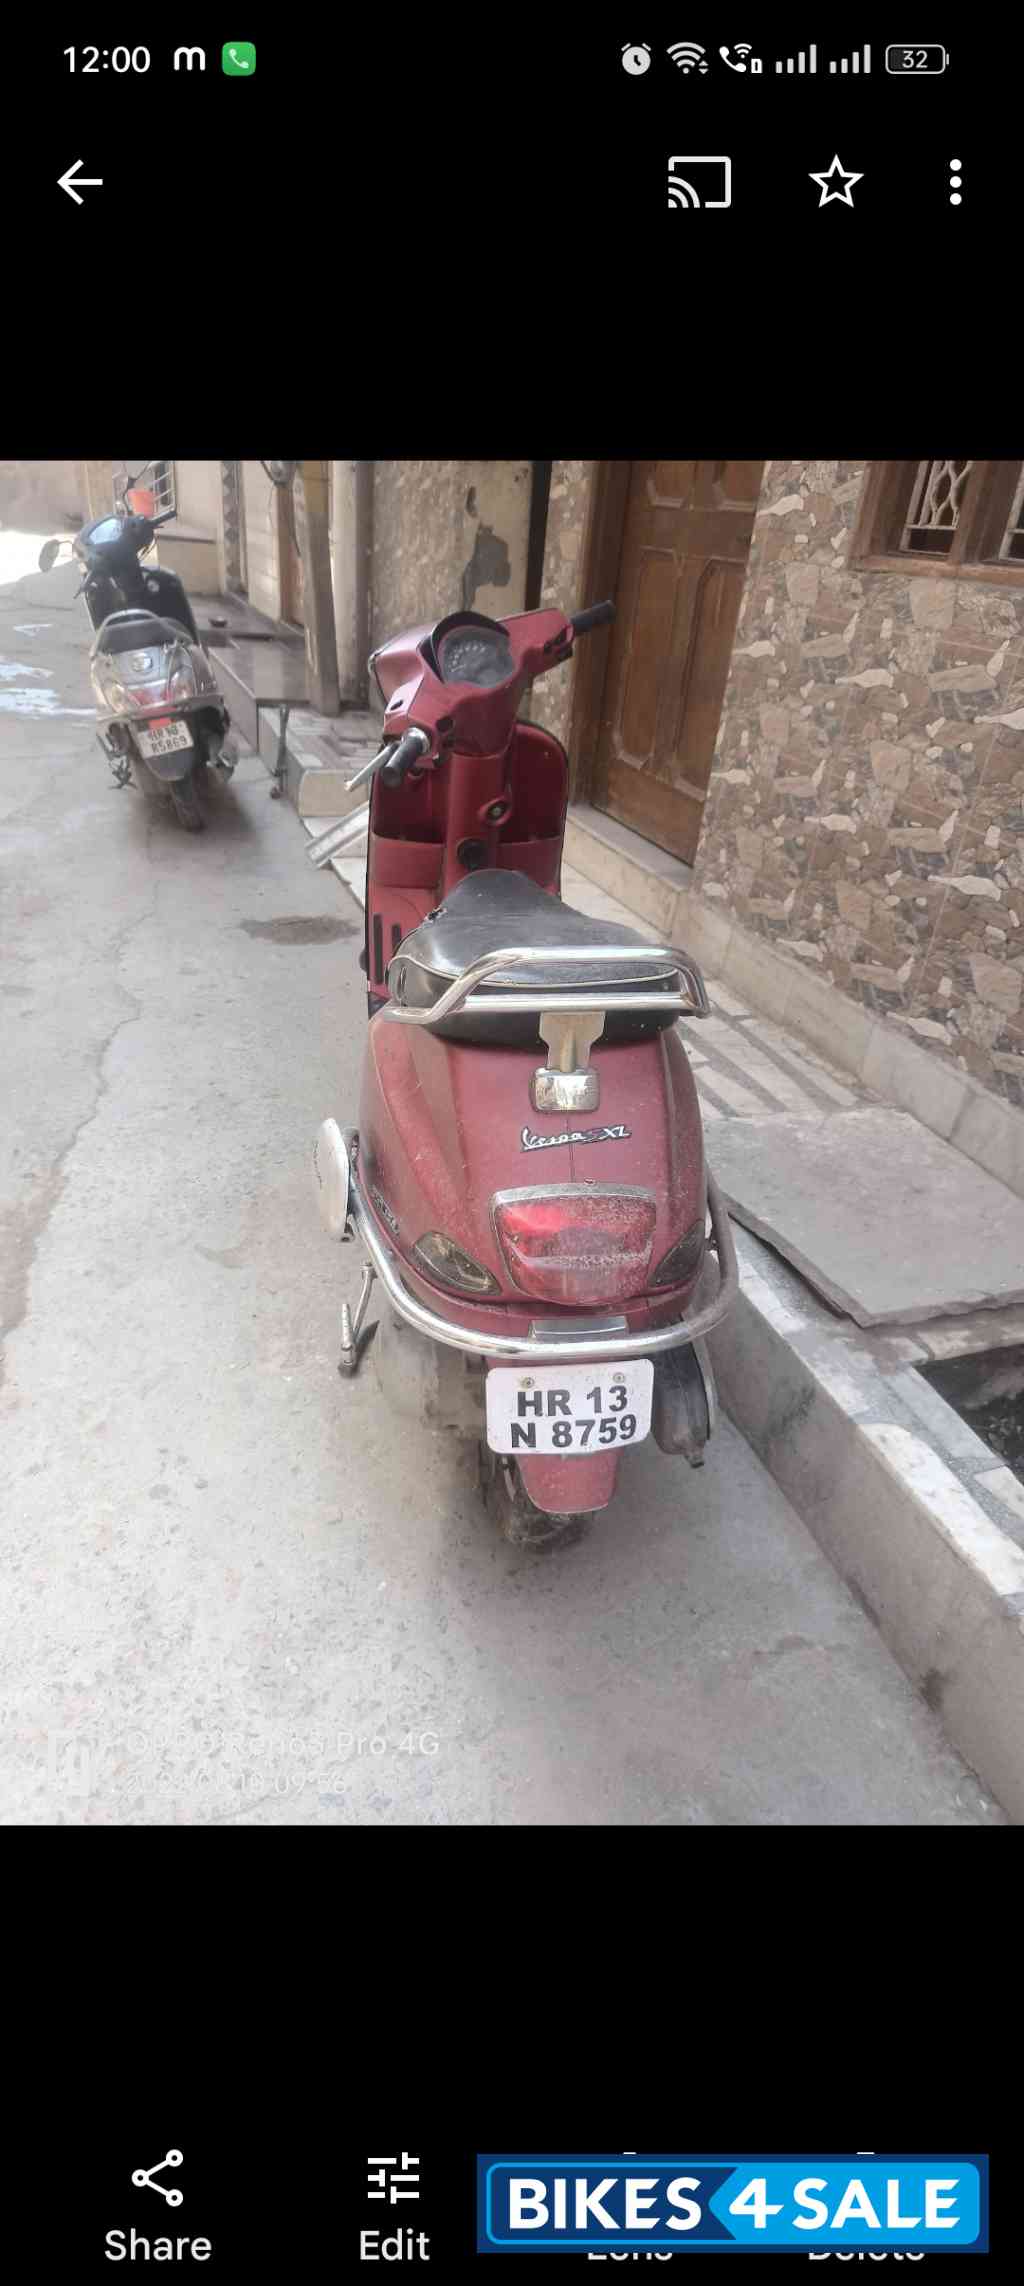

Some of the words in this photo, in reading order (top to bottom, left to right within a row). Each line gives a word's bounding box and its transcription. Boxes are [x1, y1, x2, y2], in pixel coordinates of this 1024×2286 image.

[63, 46, 151, 73] 12:00
[902, 50, 928, 69] 32
[516, 1389, 572, 1418] HR
[586, 1385, 628, 1414] 13
[510, 1421, 537, 1449] N
[551, 1413, 637, 1449] 8759
[104, 2228, 212, 2262] Share
[359, 2228, 430, 2262] Edit
